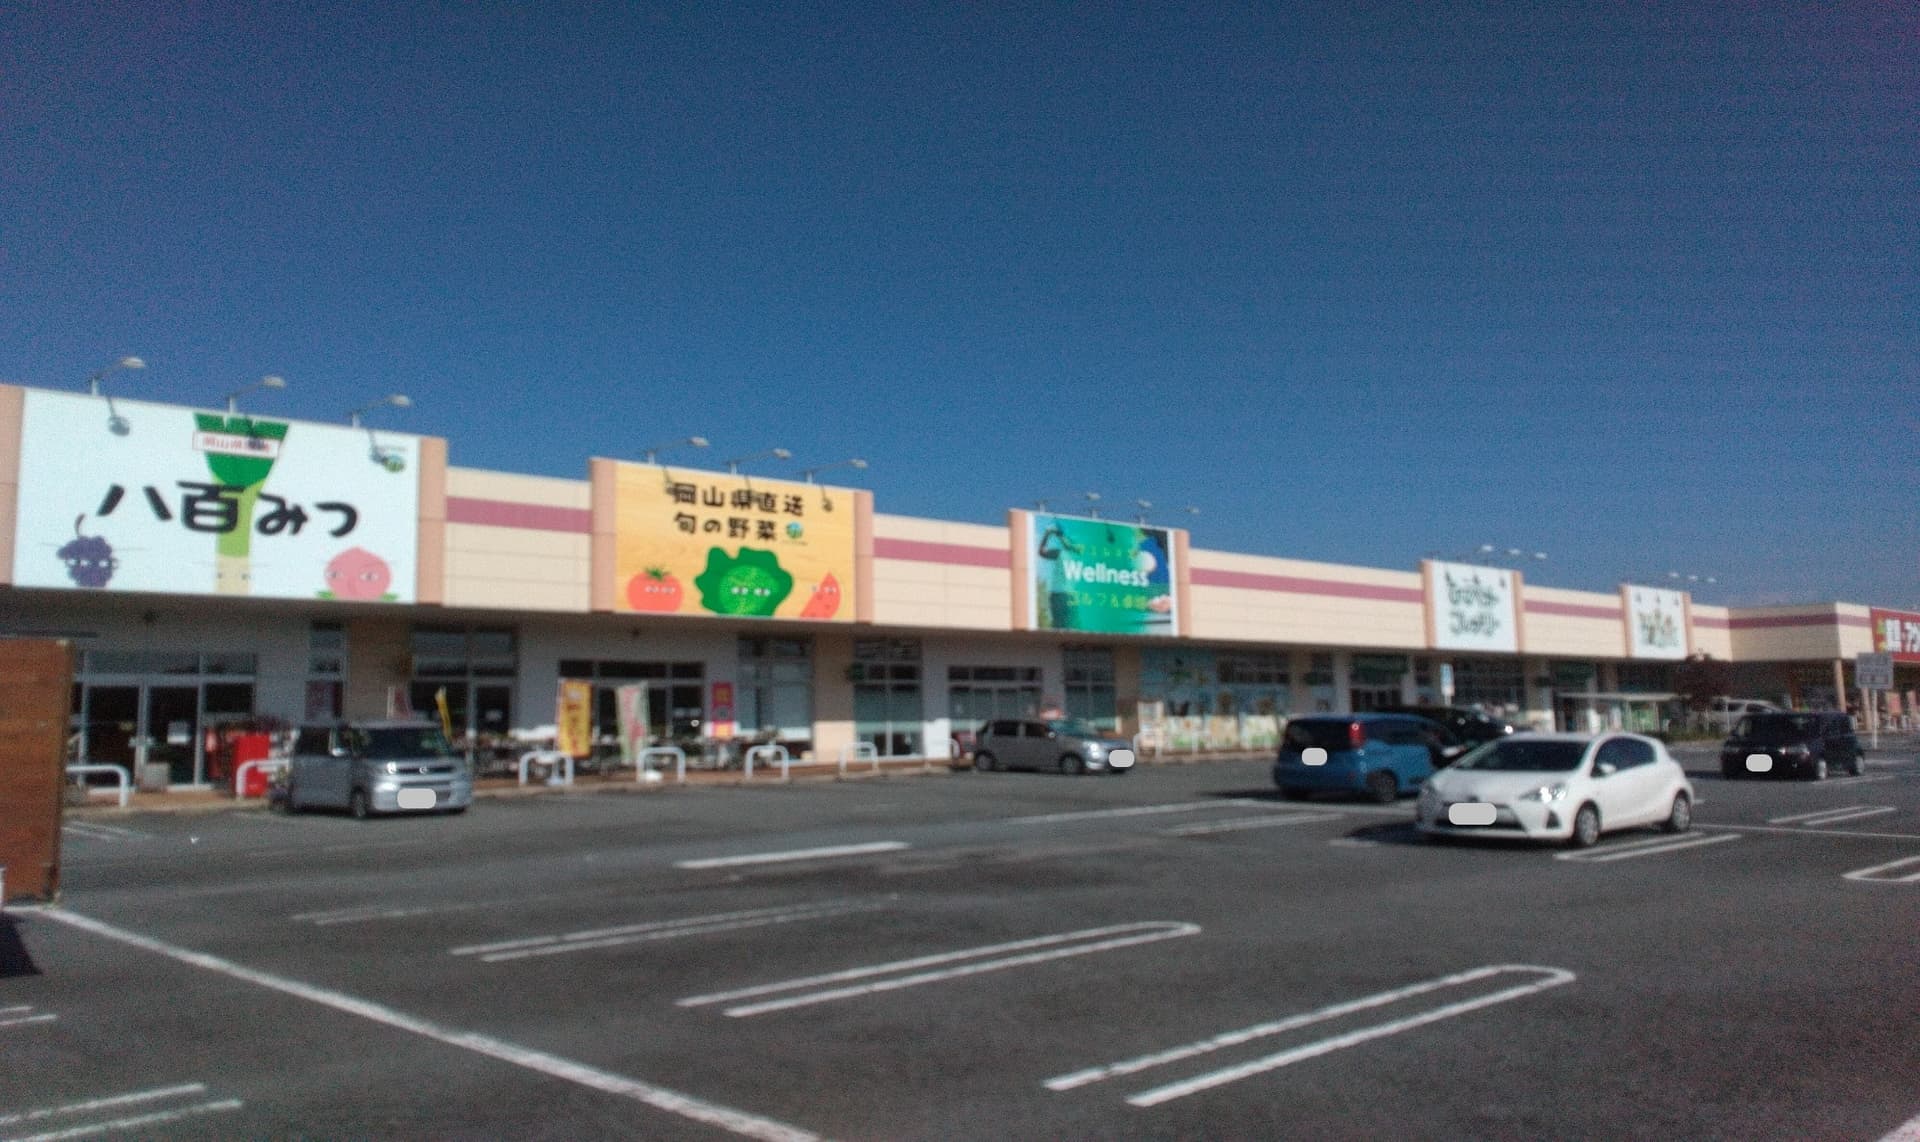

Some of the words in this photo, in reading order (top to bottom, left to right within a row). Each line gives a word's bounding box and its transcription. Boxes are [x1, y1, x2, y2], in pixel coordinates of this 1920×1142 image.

[97, 480, 360, 538] 八百みつ
[673, 482, 804, 517] 岡山県直送
[673, 512, 778, 541] 旬の野菜
[1063, 559, 1150, 587] Wellness
